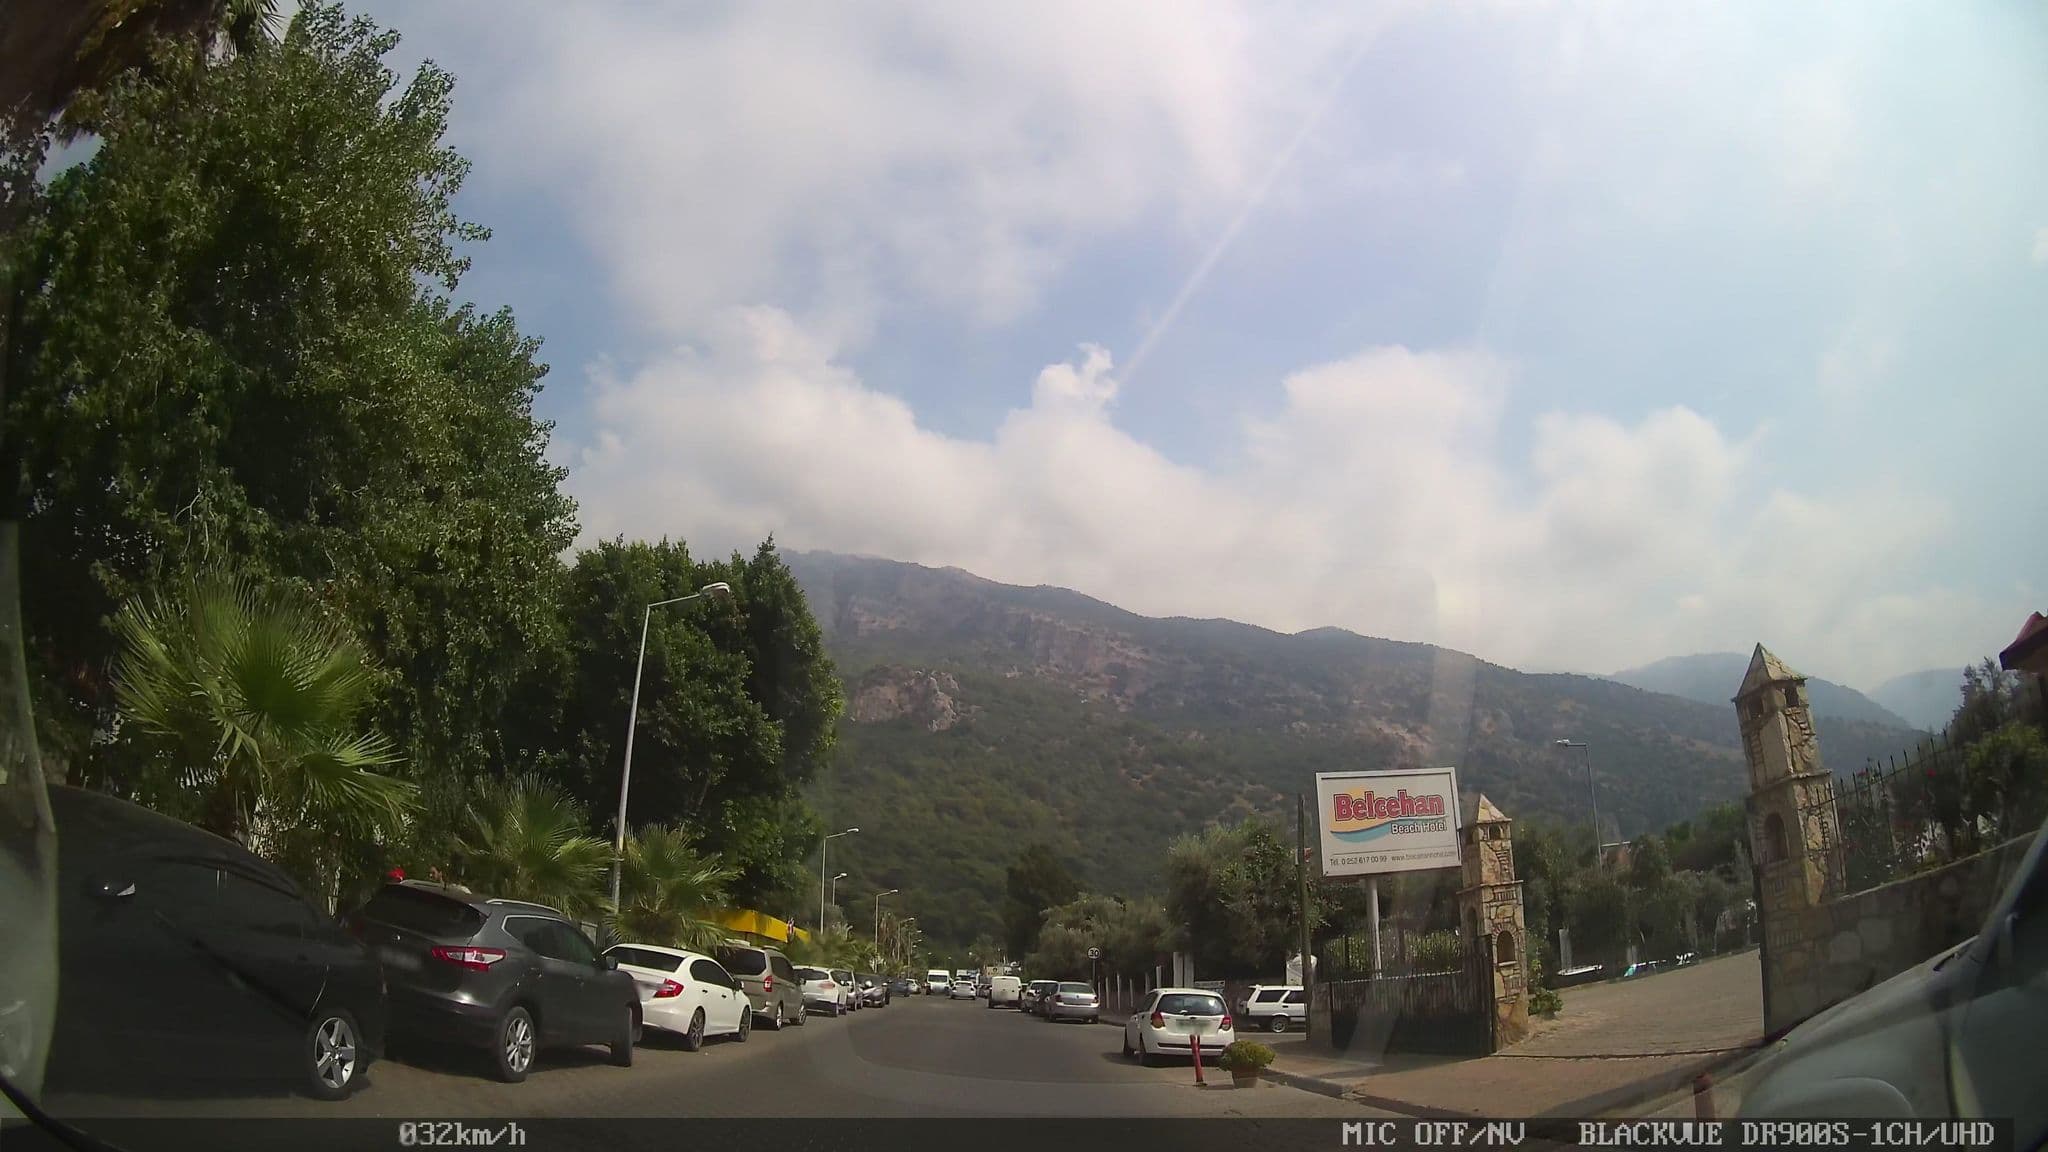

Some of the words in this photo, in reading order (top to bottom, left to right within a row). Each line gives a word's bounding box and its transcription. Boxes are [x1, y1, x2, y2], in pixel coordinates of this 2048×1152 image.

[1333, 789, 1445, 822] Belcehan
[1391, 822, 1422, 834] Beach
[1423, 821, 1447, 833] Hotel
